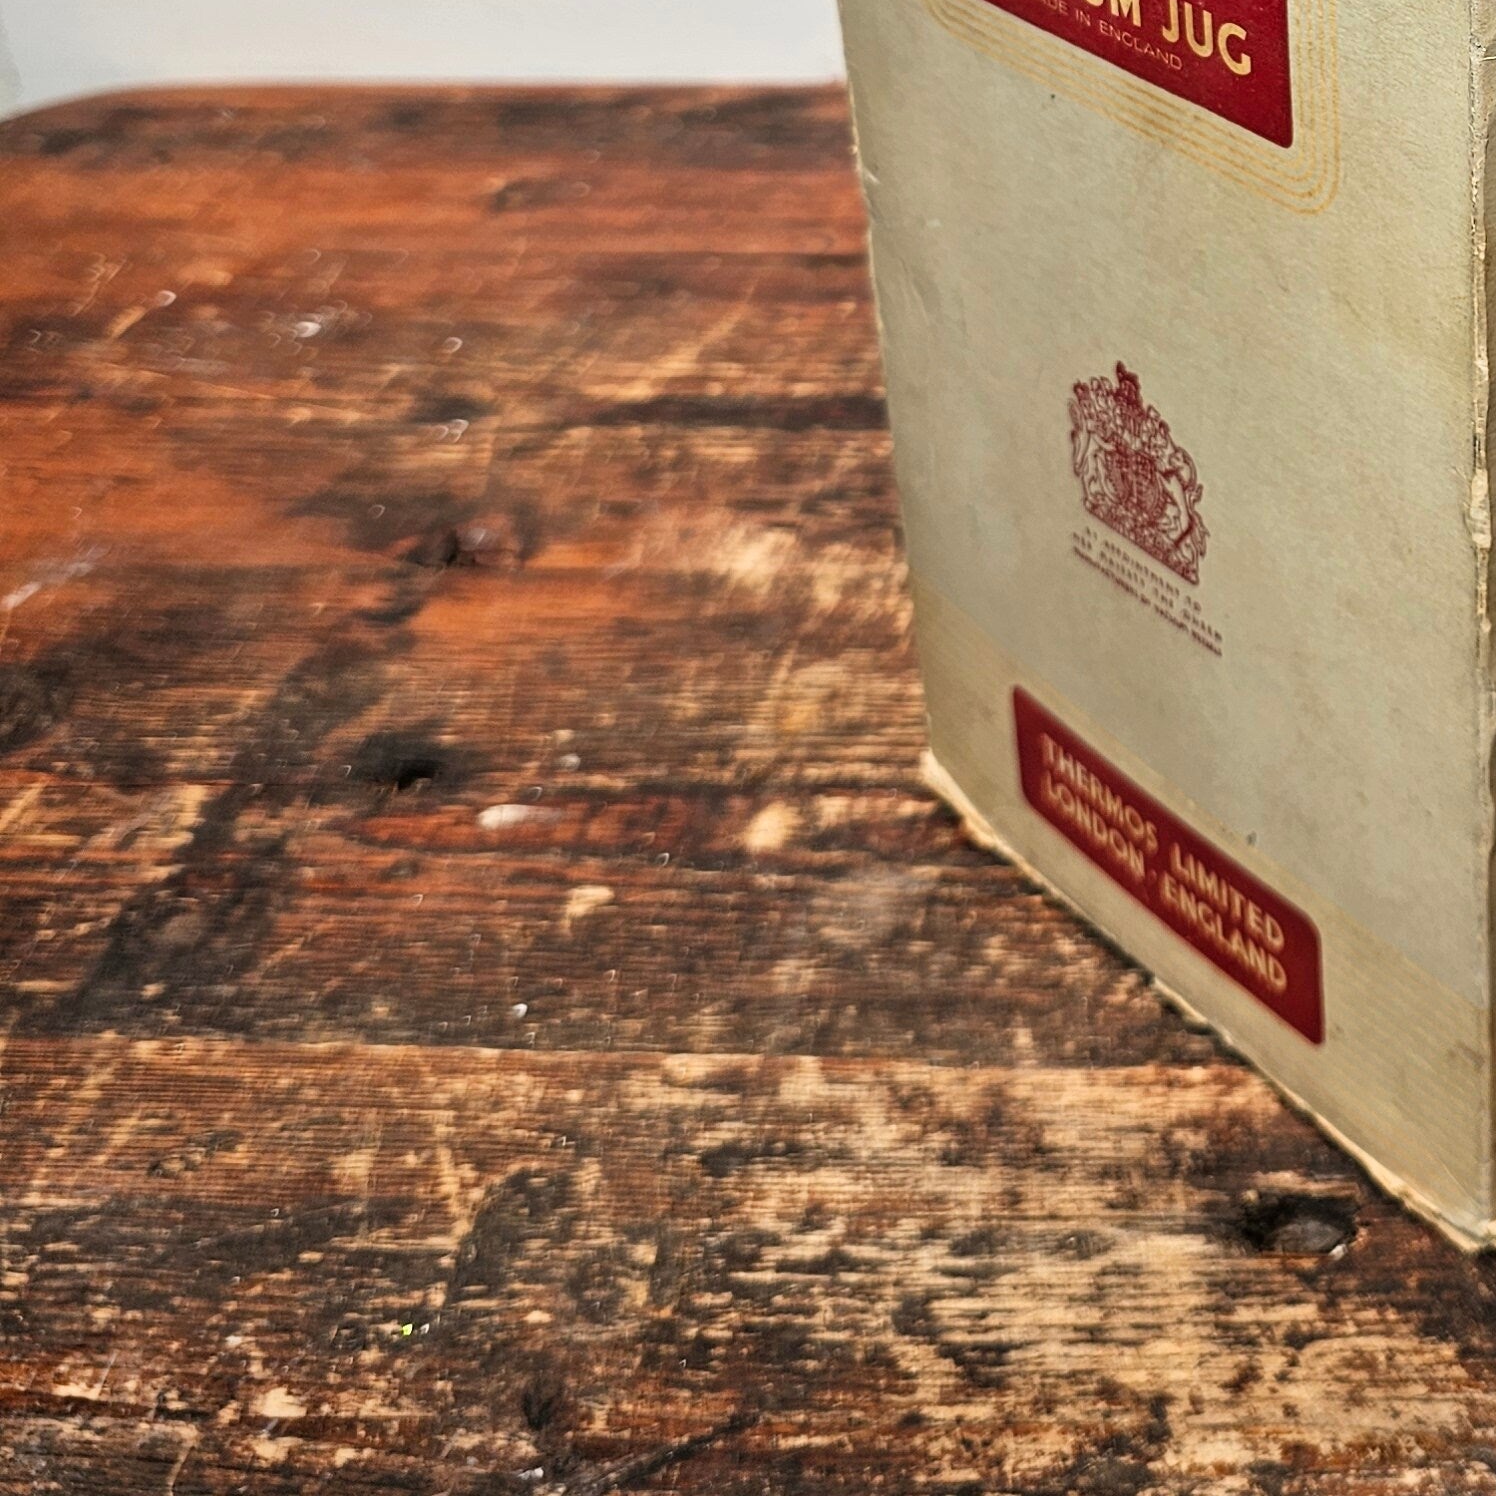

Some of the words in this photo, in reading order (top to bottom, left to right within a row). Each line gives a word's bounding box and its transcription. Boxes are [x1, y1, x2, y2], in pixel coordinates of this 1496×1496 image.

[1075, 8, 1091, 28] IN
[1099, 18, 1184, 72] ENGLAND
[1040, 731, 1158, 855] THERMOS
[1170, 842, 1285, 952] LIMITED
[1040, 771, 1146, 884] LONDON
[1160, 872, 1287, 993] ENGLAND
